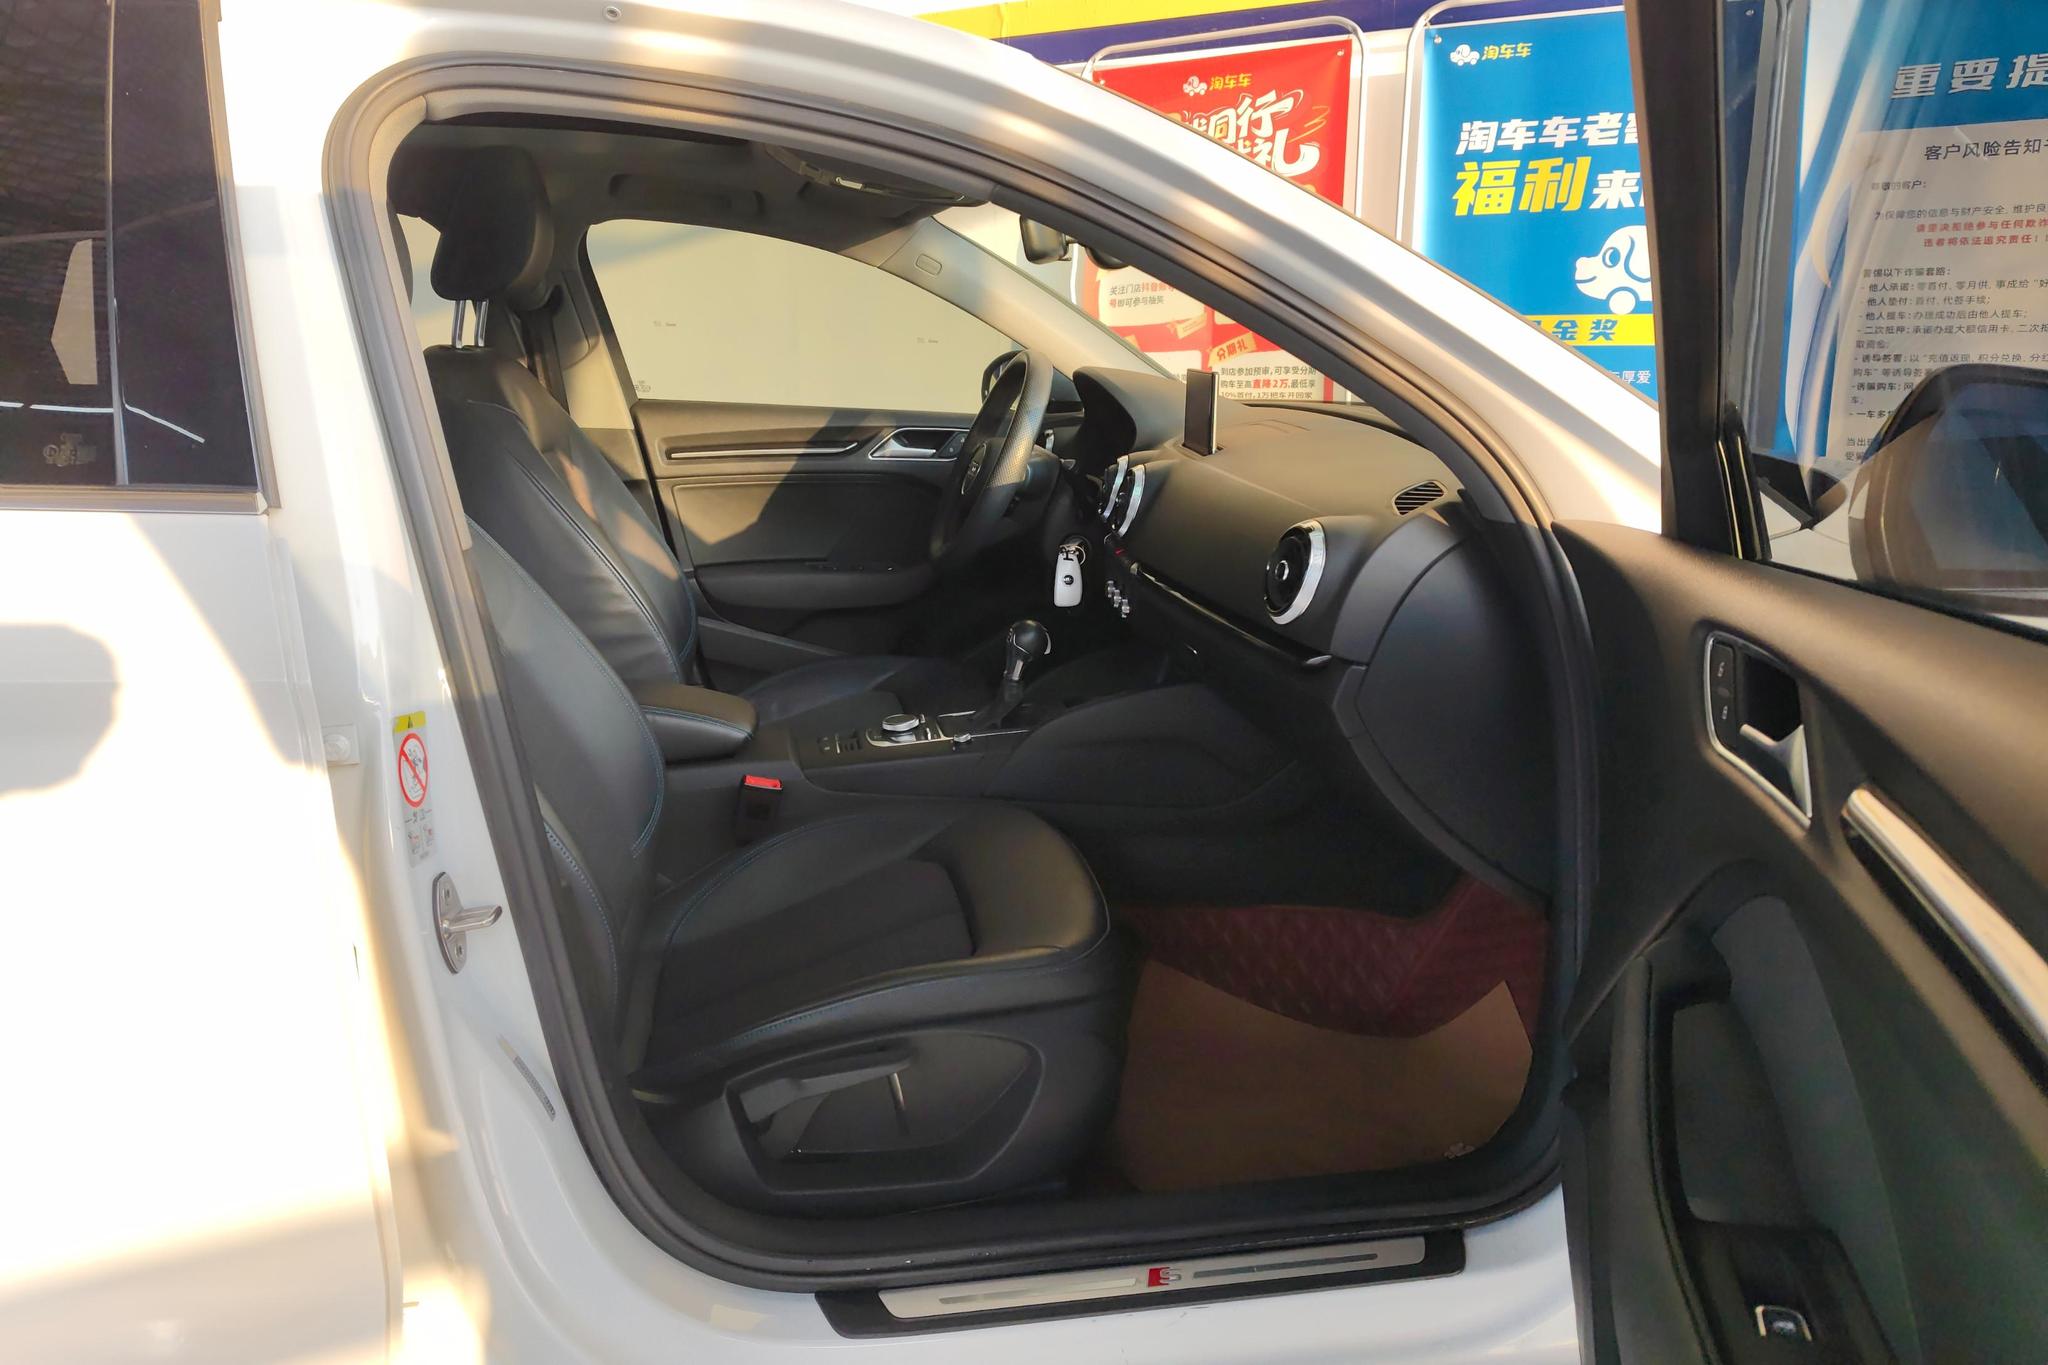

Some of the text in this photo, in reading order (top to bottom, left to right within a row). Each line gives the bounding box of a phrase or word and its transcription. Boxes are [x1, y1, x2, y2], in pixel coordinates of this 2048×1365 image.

[1482, 43, 1533, 61] 淘车车
[1210, 73, 1253, 91] 淘车车
[1891, 53, 2048, 99] 重要提
[1452, 156, 1644, 217] 福利来
[1533, 319, 1618, 341] 金奖
[1609, 369, 1652, 385] 厚爱
